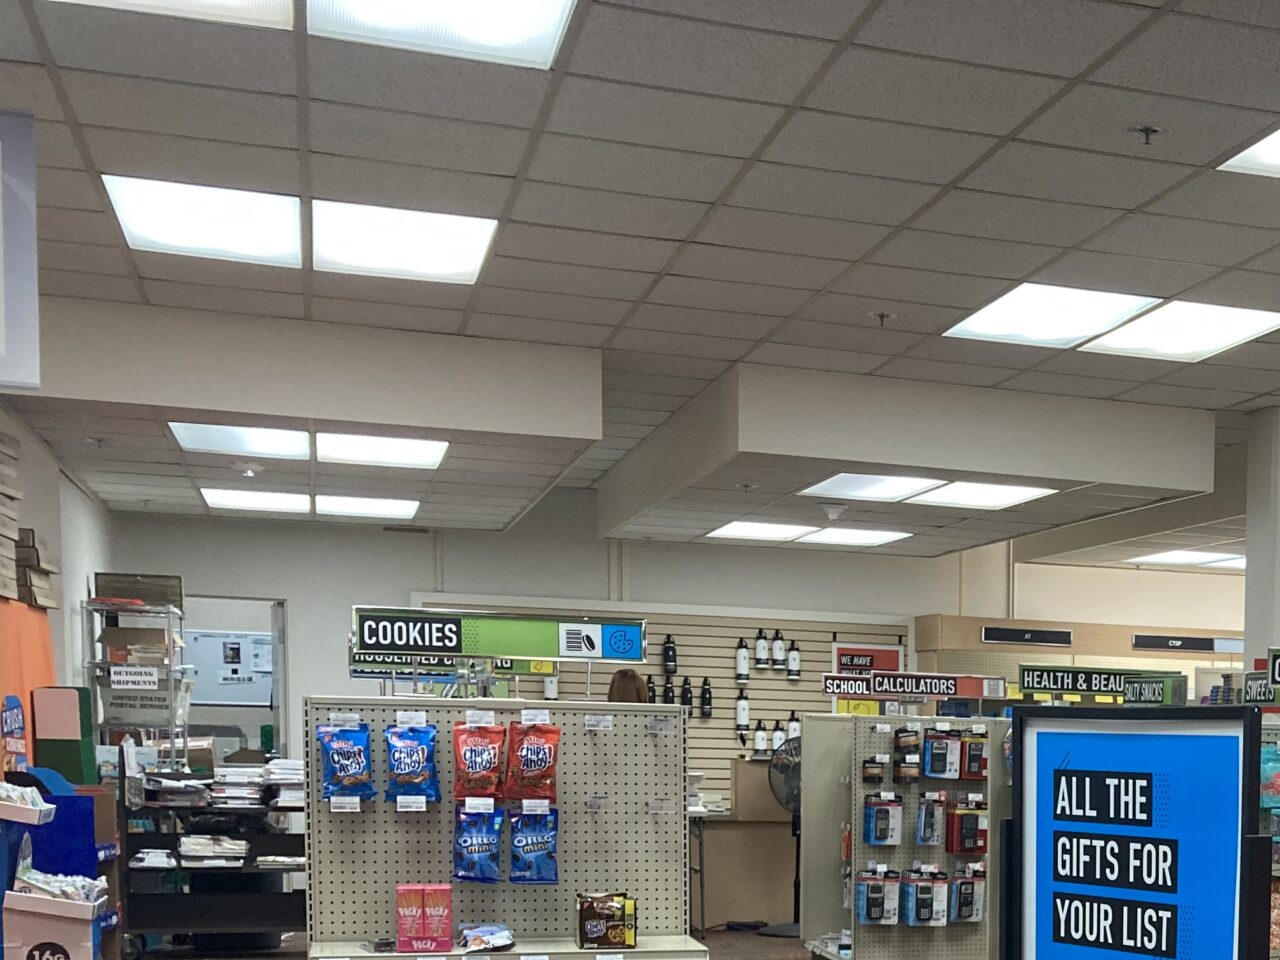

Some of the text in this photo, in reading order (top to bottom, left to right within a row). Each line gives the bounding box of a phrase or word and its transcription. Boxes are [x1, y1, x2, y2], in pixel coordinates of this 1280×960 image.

[363, 620, 458, 647] COOKIES
[840, 655, 872, 666] WE HAVE
[111, 679, 157, 687] SHIPMENTS
[826, 679, 869, 694] SCHOOL
[875, 676, 956, 694] CALCULATORS
[1024, 671, 1073, 690] HEALTH
[1077, 673, 1088, 690] &
[1125, 683, 1163, 702] SALTY SNACKS
[1056, 775, 1148, 820] ALL THE
[459, 835, 497, 847] OREO
[467, 844, 493, 854] mini
[513, 835, 552, 847] OREO
[522, 844, 548, 854] mini
[1057, 836, 1172, 887] GIFTS FOR
[1055, 898, 1172, 951] YOUR LIST
